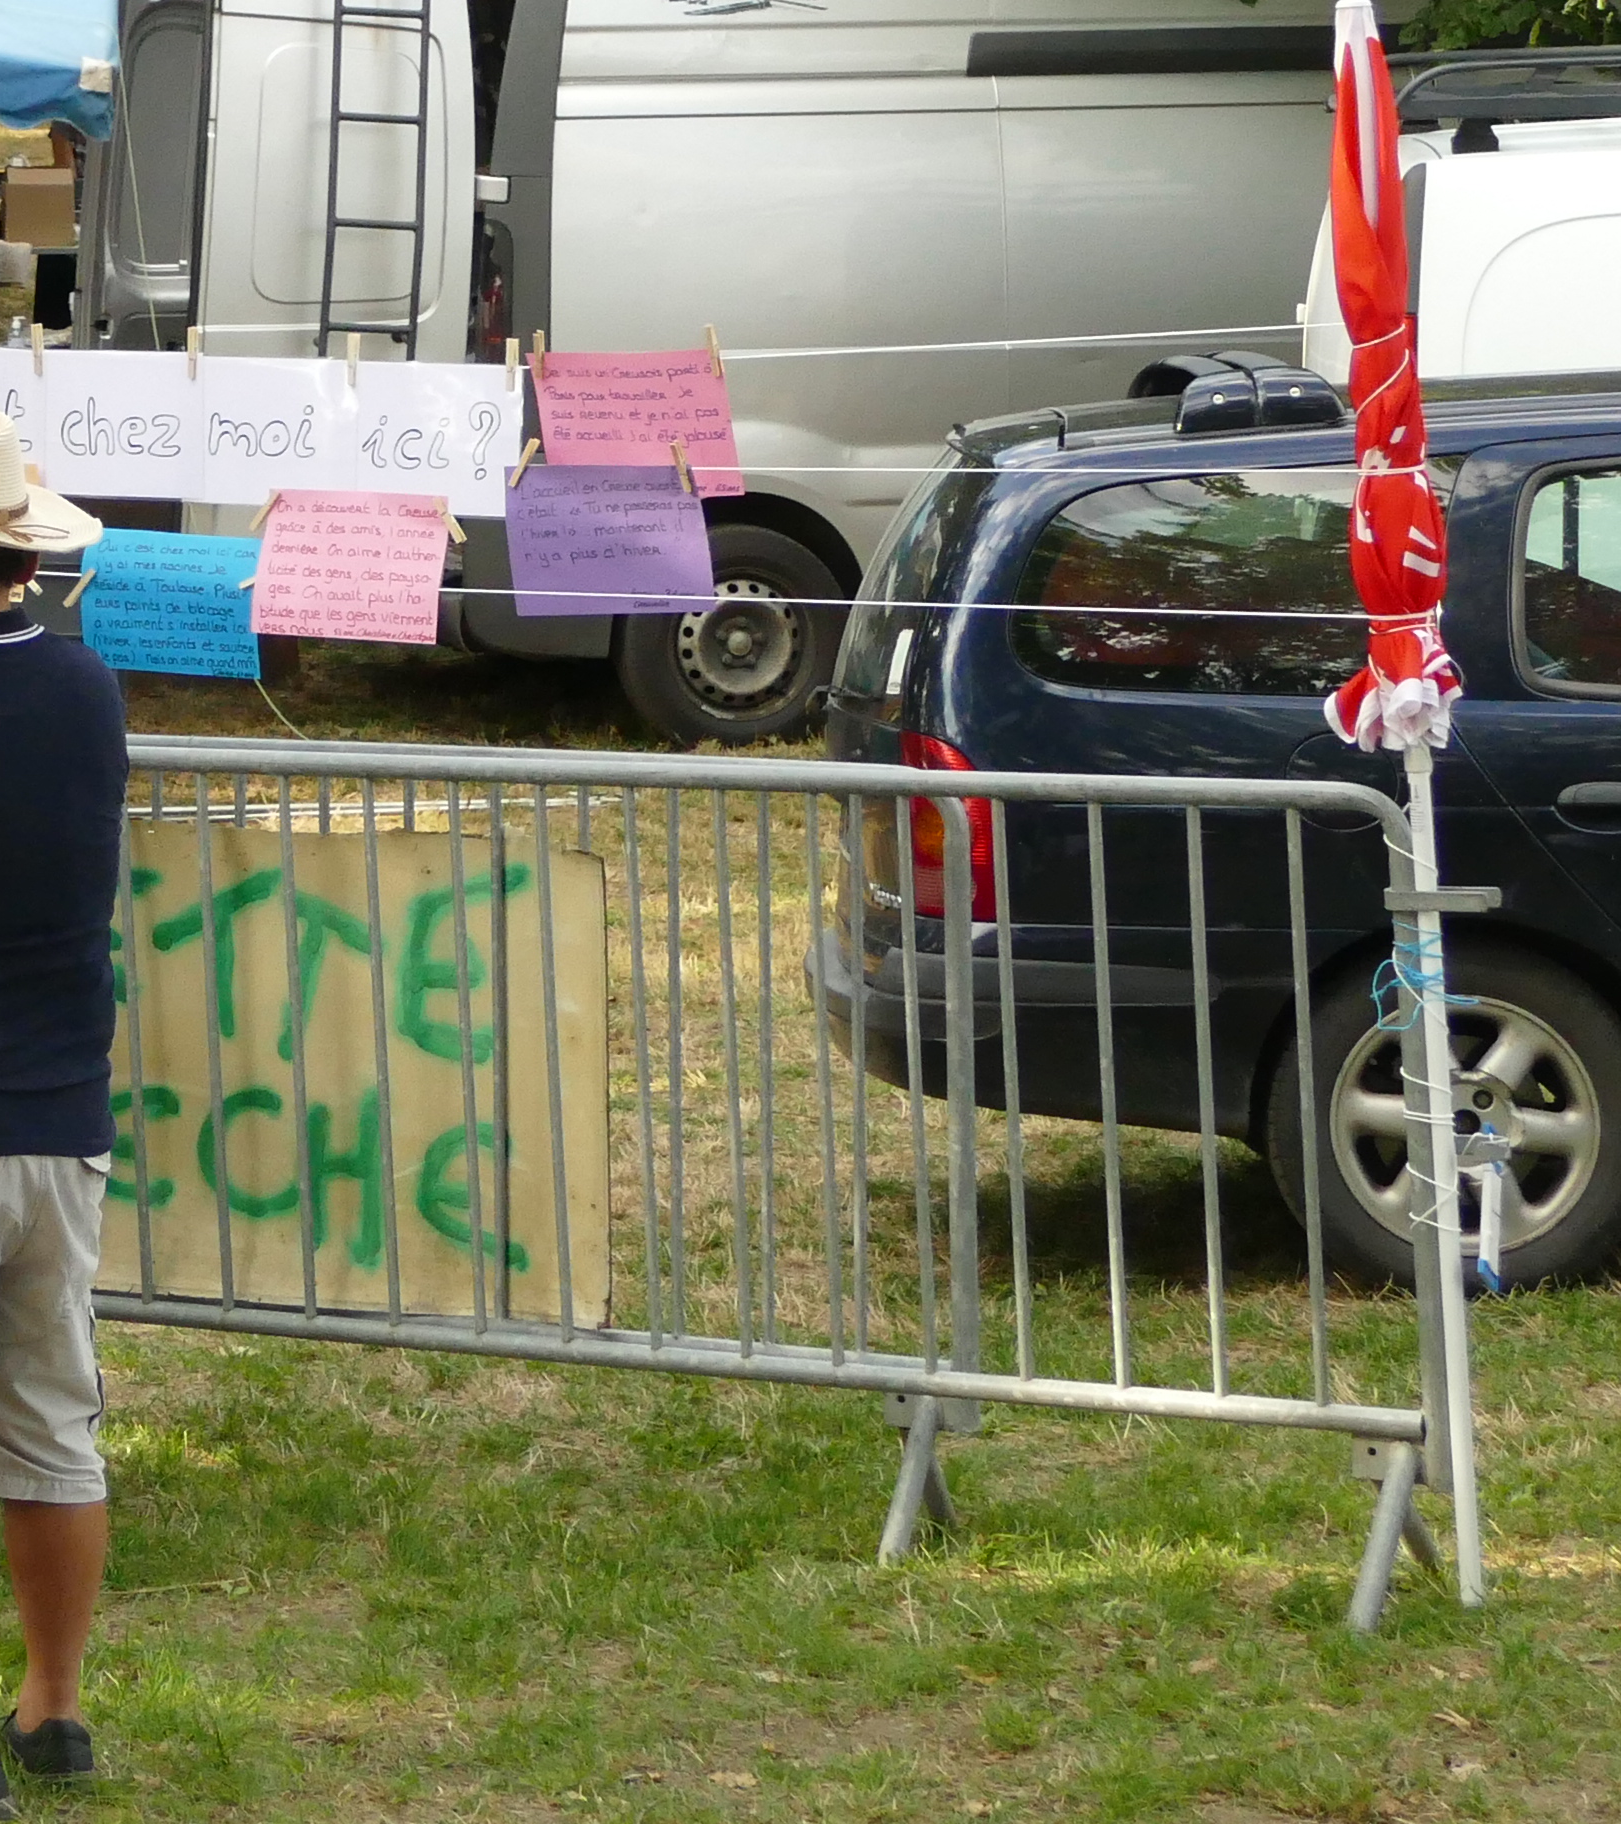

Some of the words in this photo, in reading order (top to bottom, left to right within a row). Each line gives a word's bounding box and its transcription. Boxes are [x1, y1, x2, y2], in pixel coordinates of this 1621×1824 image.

[543, 385, 576, 400] Paris
[550, 410, 575, 420] suis
[628, 407, 642, 420] et
[694, 407, 720, 422] pas
[60, 396, 182, 458] chez
[208, 404, 316, 458] moi
[361, 415, 450, 470] ici
[469, 401, 502, 481] ?
[520, 481, 580, 500] L'accueil
[582, 483, 599, 494] en
[276, 498, 294, 514] On
[297, 504, 306, 513] a
[310, 500, 372, 514] découvert
[377, 501, 392, 517] la
[582, 500, 601, 514] Tu
[677, 501, 699, 516] pas
[325, 521, 346, 534] des
[159, 546, 184, 555] chez
[187, 547, 211, 556] moi
[216, 547, 230, 556] ici
[234, 549, 257, 559] car
[327, 543, 344, 557] On
[347, 548, 382, 559] aime
[133, 561, 156, 571] mes
[207, 564, 228, 575] Je
[302, 561, 322, 578] des
[360, 567, 385, 581] des
[134, 576, 147, 592] à
[302, 584, 323, 600] On
[326, 587, 365, 602] avait
[368, 590, 395, 608] plus
[94, 597, 121, 609] eurs
[124, 598, 160, 614] points
[165, 599, 184, 613] de
[188, 601, 236, 621] blocage
[259, 604, 296, 619] bitude
[298, 609, 322, 626] que
[326, 607, 343, 622] les
[346, 609, 378, 628] gens
[381, 610, 434, 626] viennent
[107, 615, 164, 631] vraiment
[138, 637, 153, 648] les
[153, 636, 197, 650] enfants
[201, 639, 215, 652] et
[167, 656, 179, 665] on
[180, 656, 205, 666] aime
[206, 656, 236, 669] quand
